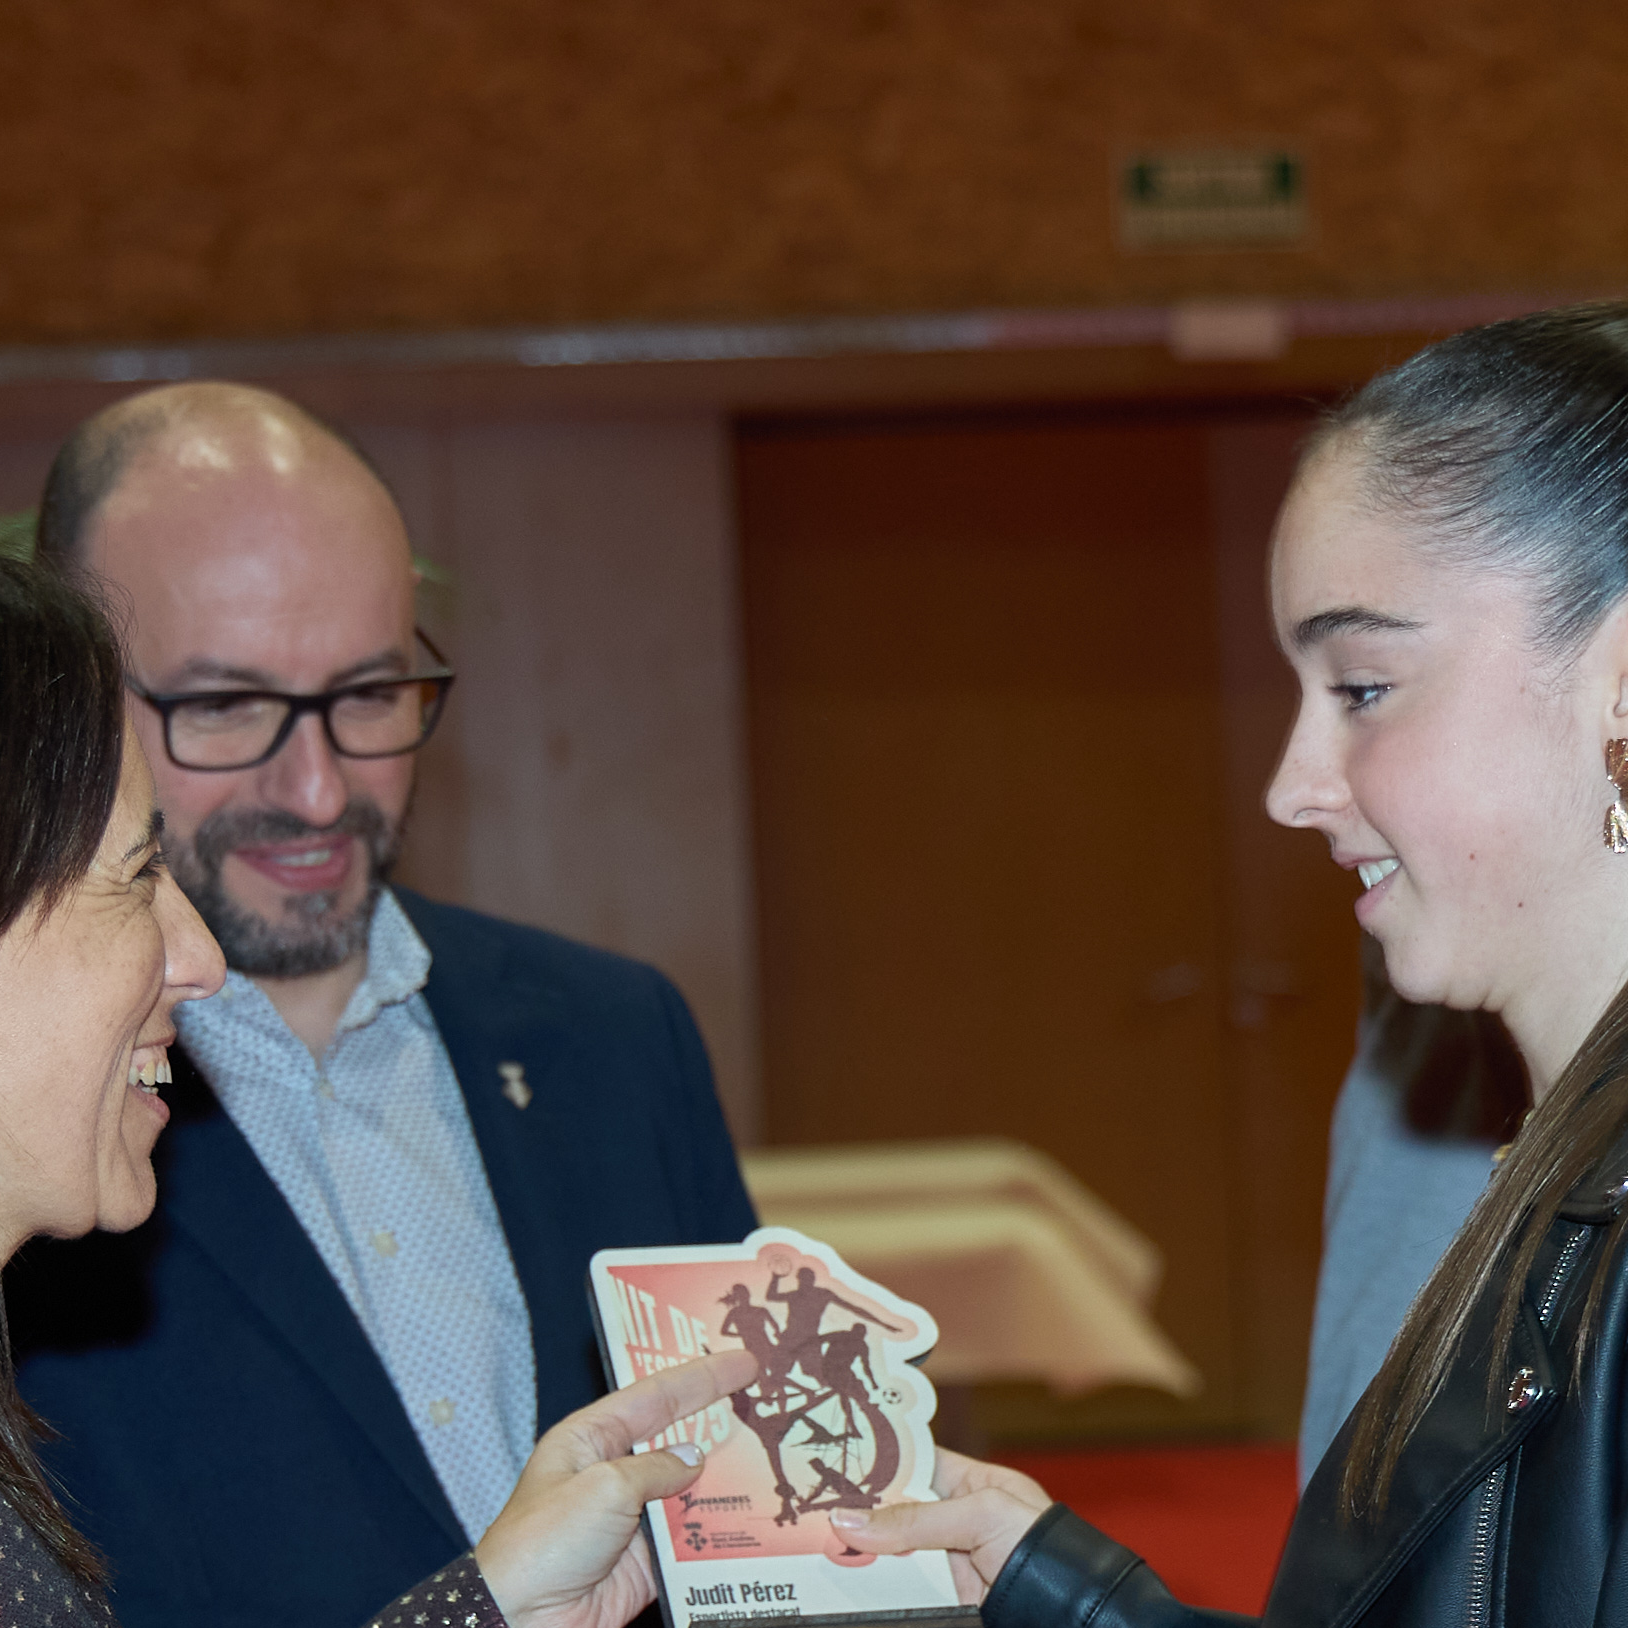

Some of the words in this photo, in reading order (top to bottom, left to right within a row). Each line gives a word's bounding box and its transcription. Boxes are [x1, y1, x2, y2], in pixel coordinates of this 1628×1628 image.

[667, 1304, 711, 1357] DE
[685, 1583, 736, 1606] Judit
[739, 1580, 797, 1604] Pérez
